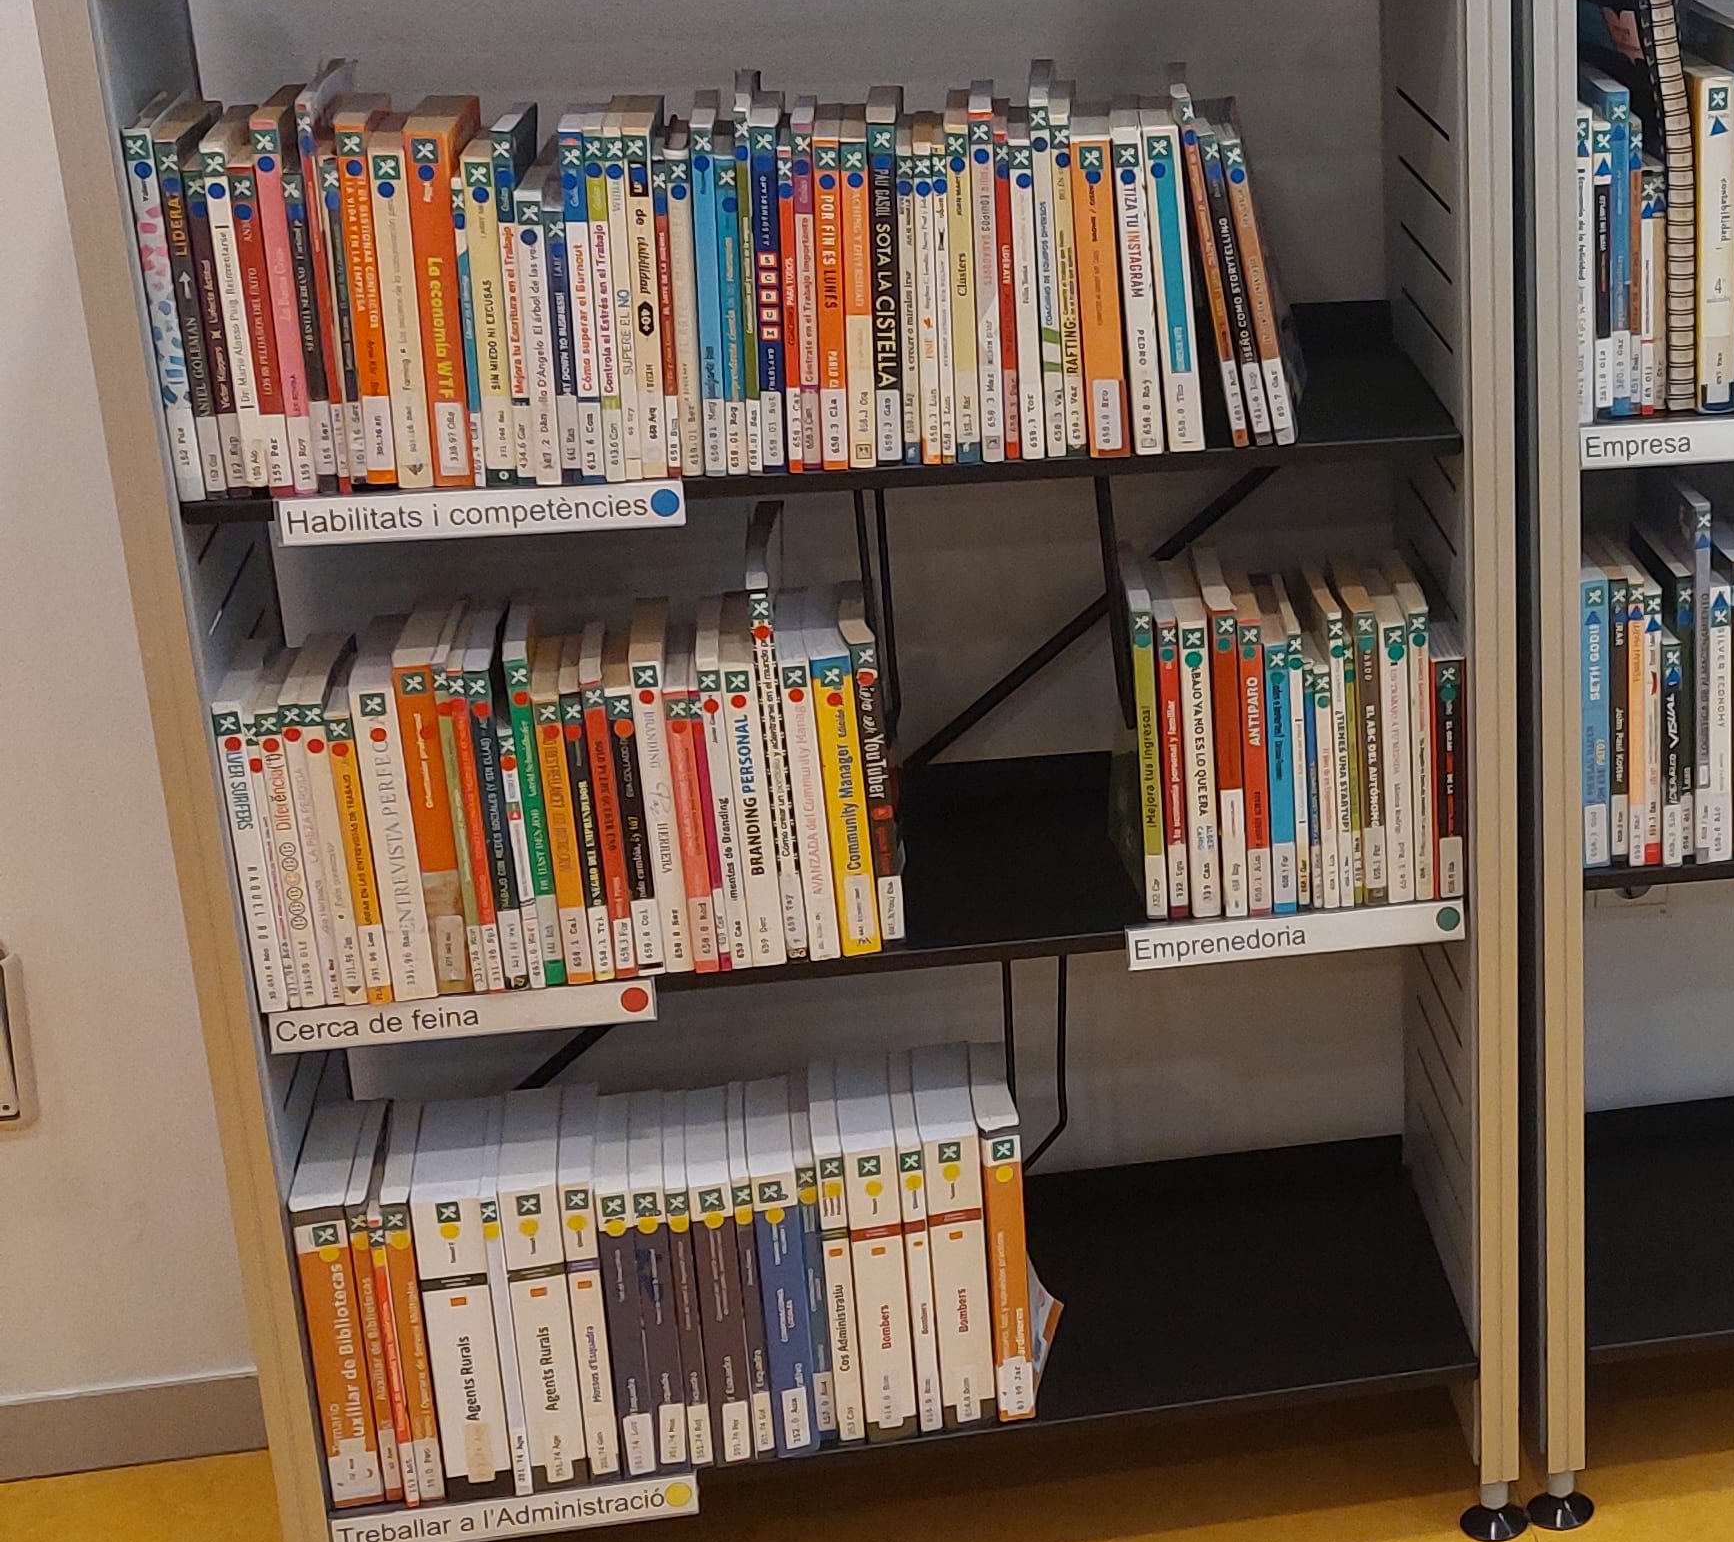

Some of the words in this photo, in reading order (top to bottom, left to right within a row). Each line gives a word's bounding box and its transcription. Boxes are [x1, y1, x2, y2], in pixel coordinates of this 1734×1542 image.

[874, 222, 892, 267] SOTA
[876, 269, 893, 293] LA
[875, 296, 898, 388] CISTELLA
[437, 360, 455, 399] WTF
[1584, 434, 1691, 464] Empresa
[286, 499, 423, 535] Habilitats
[432, 502, 440, 528] i
[449, 494, 649, 531] competències
[732, 713, 758, 795] PERSONAL
[837, 742, 857, 797] Manager
[740, 796, 767, 877] BRANDING
[845, 797, 864, 873] Community
[1133, 924, 1307, 963] Emprenedoria
[276, 1015, 359, 1043] Cerca
[368, 1012, 403, 1035] de
[410, 1006, 480, 1030] feina
[457, 1335, 474, 1375] Rurals
[538, 1326, 554, 1367] Rurals
[460, 1373, 481, 1422] Agents
[545, 1368, 560, 1412] Agents
[459, 1516, 475, 1533] a
[483, 1487, 665, 1530] l'Administració
